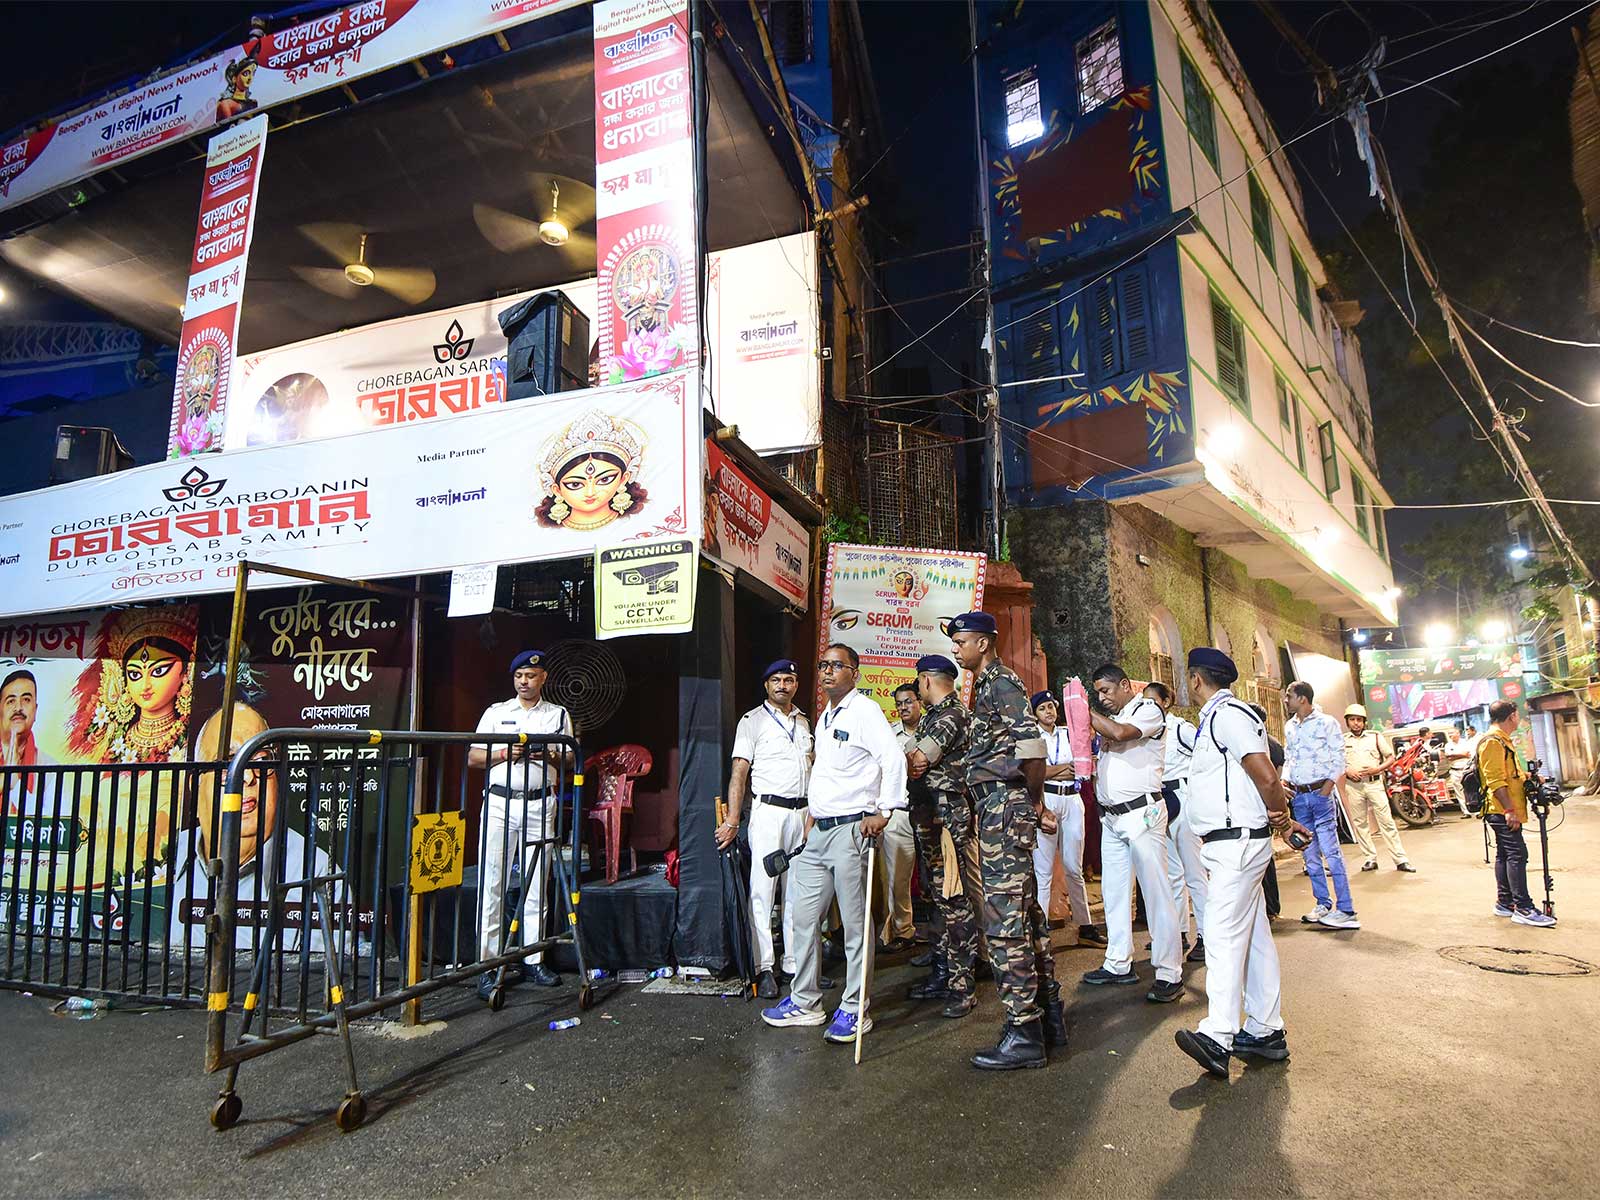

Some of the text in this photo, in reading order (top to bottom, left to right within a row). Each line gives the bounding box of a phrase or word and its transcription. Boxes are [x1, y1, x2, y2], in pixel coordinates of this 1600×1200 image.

[273, 0, 386, 50] বাংলাকে রক্ষা
[622, 12, 646, 23] News
[268, 18, 386, 67] করার জন্য ধন্যবাদ
[601, 67, 685, 110] বাংলাকে
[58, 115, 92, 136] Bengal's
[94, 108, 109, 121] No.
[118, 91, 146, 110] digital
[147, 82, 174, 99] News
[176, 62, 219, 86] Network
[625, 101, 657, 120] করার
[202, 193, 250, 229] বাংলাকে
[197, 229, 245, 263] ধন্যবাদ
[357, 364, 455, 393] CHOREBAGAN
[416, 447, 487, 464] Media Partner
[51, 477, 368, 535] CHOREBAGAN SARBOJANIN
[49, 490, 371, 562] চোরবাগান
[48, 538, 221, 572] DURGOTSAB
[241, 521, 369, 546] SAMITY
[609, 543, 683, 560] WARNING
[136, 556, 184, 571] ESTD
[203, 549, 248, 563] 1936
[875, 590, 898, 598] SERUM
[614, 599, 677, 610] YOU ARE UNDER
[626, 607, 665, 618] CCTV
[259, 586, 326, 658] তুমি
[614, 615, 676, 625] SURVEILLANCE
[866, 612, 934, 632] SERUM Group
[886, 628, 914, 636] Presents
[893, 636, 923, 645] Biggest
[865, 648, 894, 656] Sharod
[880, 643, 907, 651] Crown
[293, 635, 377, 701] নীরবে
[301, 704, 371, 721] মোহনবাগানের
